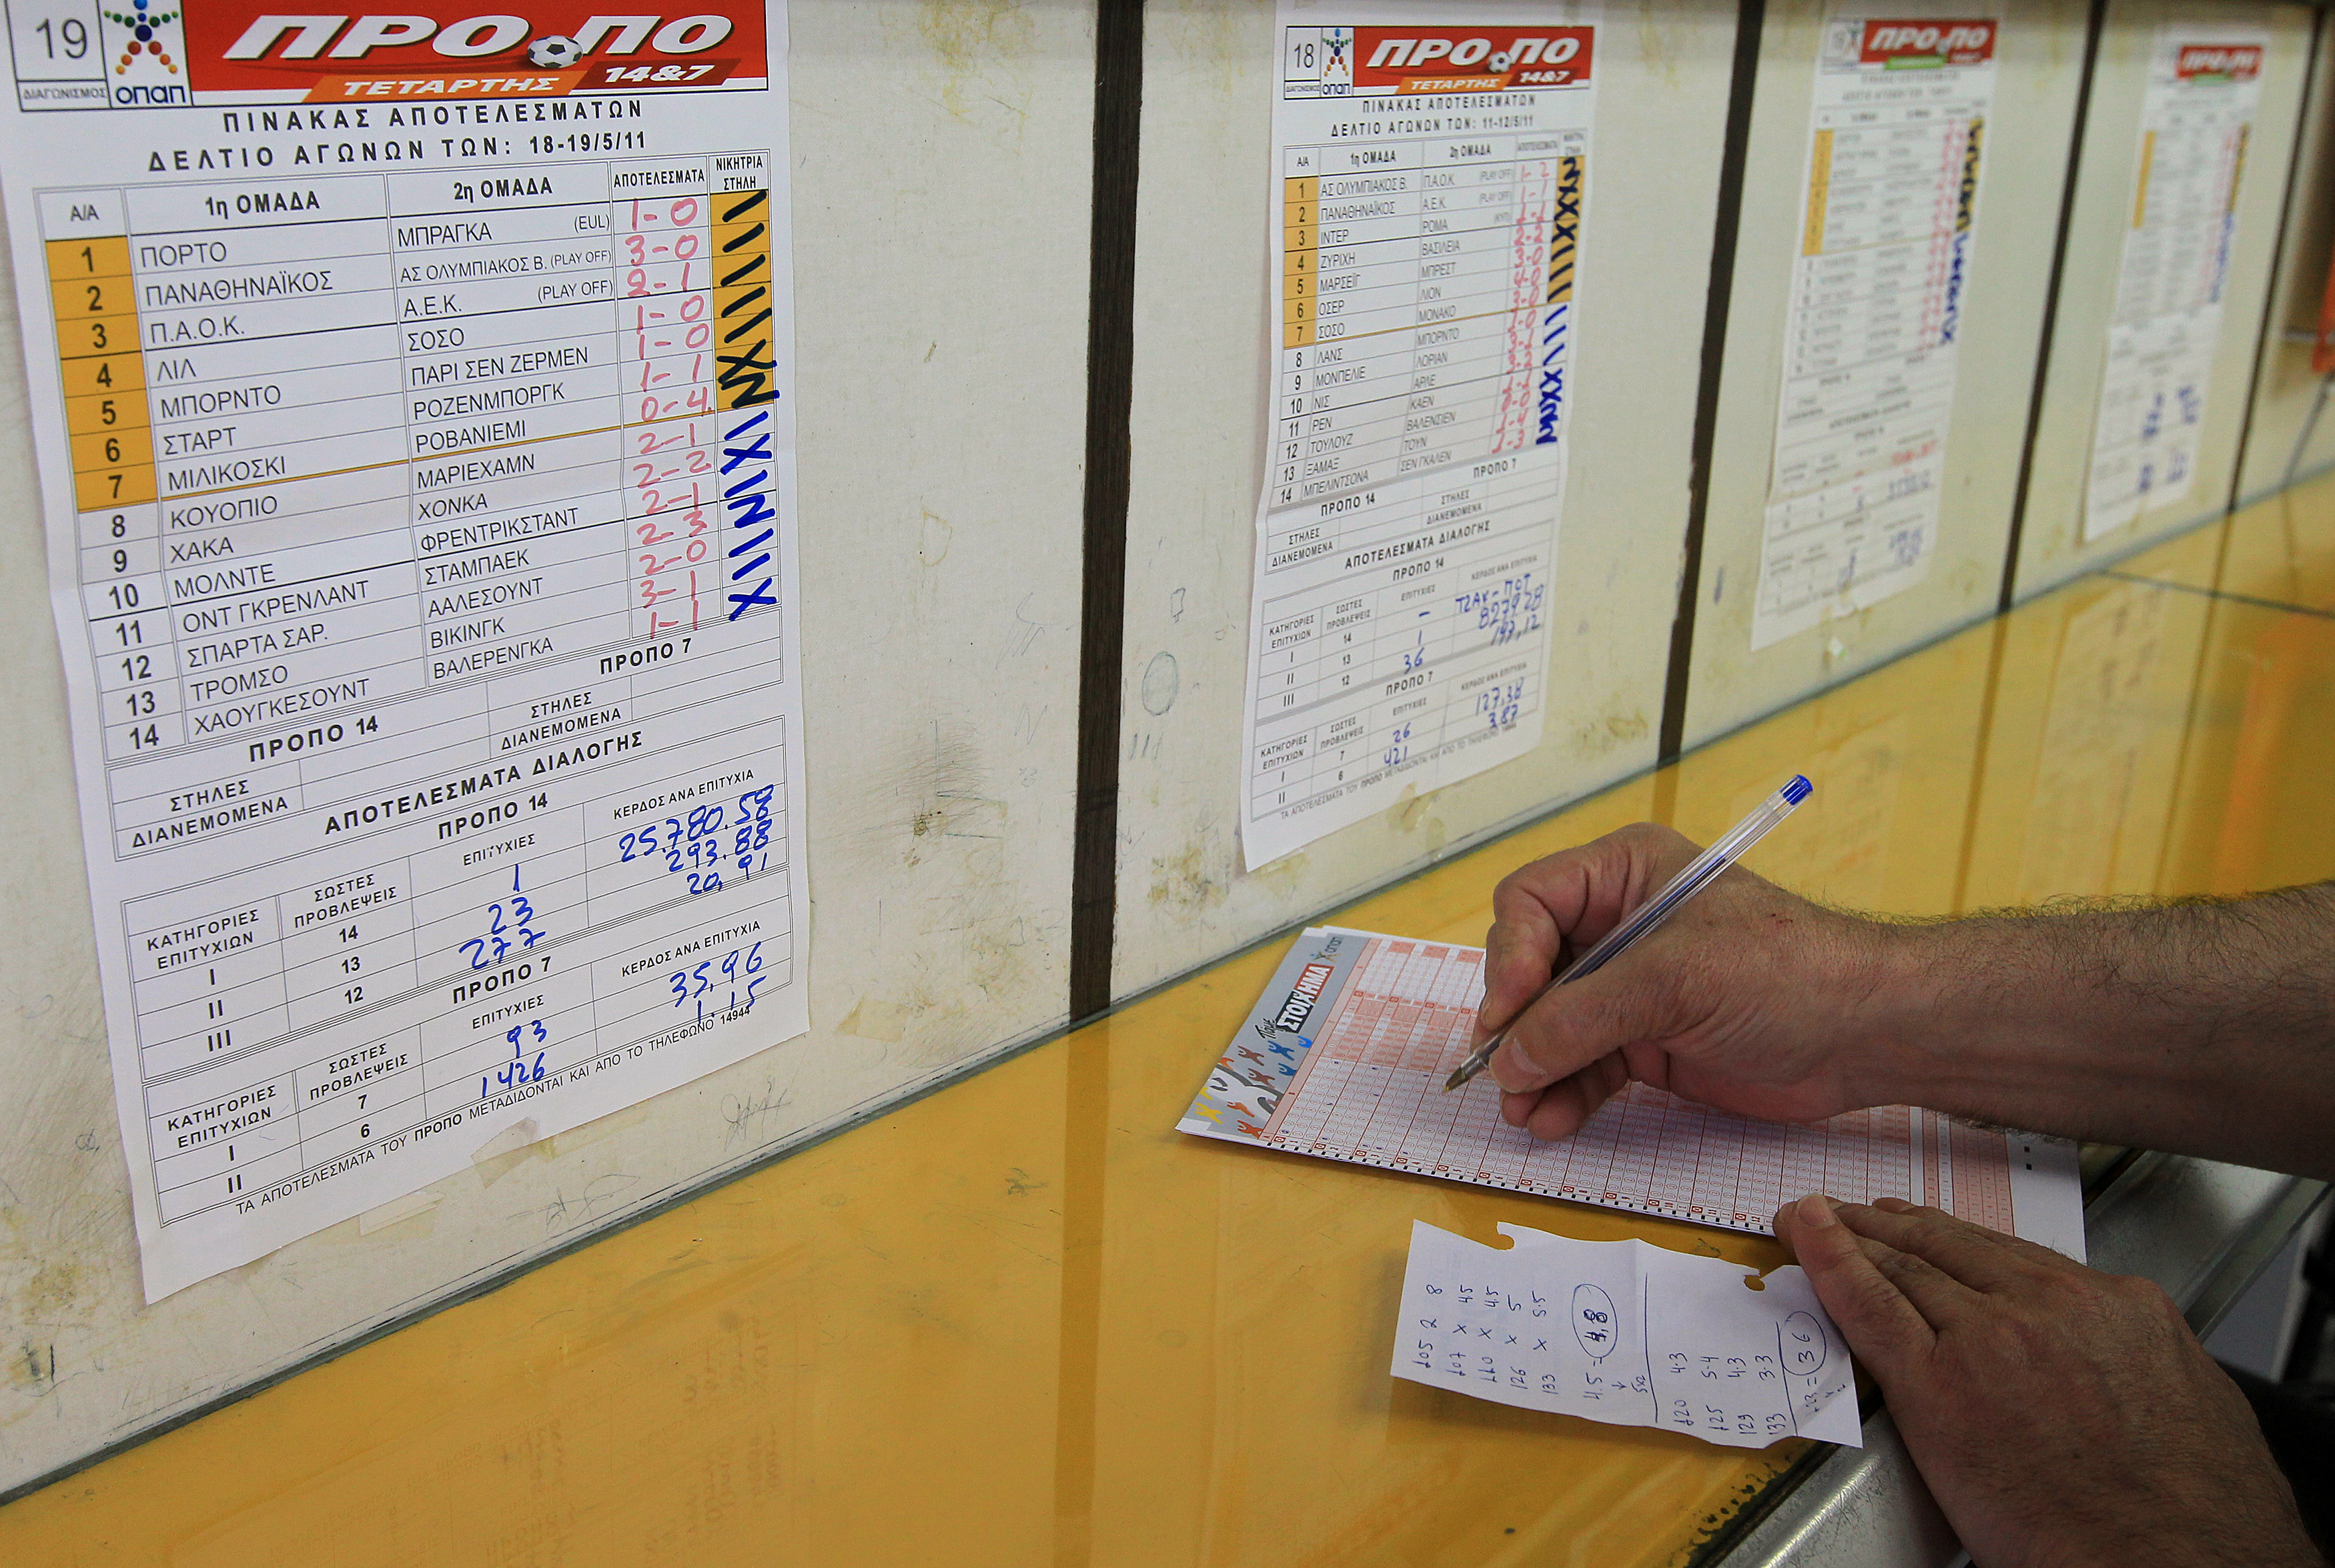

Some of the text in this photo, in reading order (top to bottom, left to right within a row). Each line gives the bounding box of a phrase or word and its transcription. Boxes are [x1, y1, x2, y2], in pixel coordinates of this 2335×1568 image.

[36, 19, 87, 59] 19
[1294, 43, 1314, 68] 18
[343, 77, 565, 95] ΤΕΤΑΡΤΗΣ
[604, 65, 715, 83] 14&7
[1411, 78, 1501, 90] ΤΕΤΑΡΤΗΣ
[1519, 70, 1570, 83] 14&7
[23, 86, 107, 101] ΔΙΑΓΩΝΙΣΜΟΣ
[1362, 95, 1535, 113] ΠΙΝΑΚΑΣ ΑΠΟΤΕΛΕΣΜΑΤΩΝ
[223, 99, 642, 133] ΠΙΝΑΚΑΣ ΑΠΟΤΕΛΕΣΜΑΤΩΝ
[1330, 121, 1381, 137] ΔΕΛΤΙΟ
[1388, 119, 1440, 133] ΑΓΩΝΩΝ
[148, 131, 646, 172] ΔΕΛΤΙΟ ΑΓΩΝΩΝ ΤΩΝ: 18-19/5/11
[715, 155, 763, 171] ΝΙΚΗΤΡΙΑ
[1363, 151, 1396, 163] ΟΜΑΔΑ
[453, 176, 552, 203] 2η ΟΜΑΔΑ
[613, 169, 705, 188] ΑΠΟΤΕΛΕΣΜΑΤΑ
[723, 175, 757, 191] ΣΤΗΛΗ
[1320, 177, 1398, 197] ΑΣ ΟΛΥΜΠΙΑΚΟΣ
[205, 191, 320, 218] 1η ΟΜΑΔΑ
[1298, 205, 1306, 223] 2
[398, 213, 610, 248] ΜΠΡΑΓΚΑ (EUL)
[1298, 229, 1305, 246] 3
[1320, 229, 1350, 243] ΙΝΤΕΡ
[81, 247, 93, 272] 1
[140, 242, 227, 268] ΠΟΡΤΟ
[401, 265, 422, 282] ΑΣ
[426, 258, 529, 281] ΟΛΥΜΠΙΑΚΟΣ
[550, 253, 583, 267] (PLAY
[586, 249, 612, 264] OFF)
[1321, 251, 1356, 269] ΖΥΡΙΧΗ
[87, 285, 103, 311] 2
[146, 271, 333, 307] ΠΑΝΑΘΗΝΑΪΚΟΣ
[537, 284, 578, 303] (PLAY
[580, 281, 613, 297] OFF)
[1318, 299, 1345, 316] ΟΣΕΡ
[92, 324, 107, 348] 3
[151, 315, 245, 344] Π.Α.Ο.Κ.
[408, 327, 464, 352] ΣΟΣΟ
[1318, 323, 1346, 339] ΣΟΣΟ
[412, 347, 588, 386] ΠΑΡΙ ΣΕΝ ΖΕΡΜΕΝ
[1318, 347, 1343, 363] ΛΑΝΣ
[97, 363, 112, 387] 4
[157, 358, 197, 381] ΛΙΛ
[102, 401, 116, 426] 5
[161, 385, 282, 419] ΜΠΟΡΝΤΟ
[414, 382, 565, 420] ΡΟΖΕΝΜΠΟΡΓΚ
[1290, 398, 1303, 414] 10
[1314, 395, 1330, 410] ΝΙΣ
[416, 420, 525, 453] ΡΟΒΑΝΙΕΜΙ
[1289, 422, 1300, 438] 11
[1312, 417, 1332, 432] ΡΕΝ
[105, 438, 121, 463] 6
[164, 427, 236, 456] ΣΤΑΡΤ
[1286, 443, 1298, 459] 12
[1310, 433, 1353, 454] ΤΟΥΛΟΥΖ
[169, 456, 286, 491] ΜΙΛΙΚΟΣΚΙ
[418, 454, 536, 490] ΜΑΡΙΕΧΑΜΝ
[109, 475, 122, 499] 7
[1281, 488, 1292, 504] 14
[170, 496, 278, 530] ΚΟΥΟΠΙΟ
[418, 493, 488, 521] ΧΟΝΚΑ
[1322, 493, 1376, 516] ΠΡΟΠΟ 14
[111, 515, 126, 538] 8
[421, 508, 578, 554] ΦΡΕΝΤΡΙΚΣΤΑΝΤ
[1289, 527, 1320, 546] ΣΤΗΛΕΣ
[170, 537, 234, 564] ΧΑΚΑ
[1272, 541, 1334, 568] ΔΙΑΝΕΜΟΜΕΝΑ
[1344, 520, 1491, 570] ΑΠΟΤΕΛΕΣΜΑΤΑ ΔΙΑΛΟΓΗΣ
[113, 550, 128, 574] 9
[425, 548, 529, 586] ΣΤΑΜΠΑΕΚ
[1393, 561, 1431, 581] ΠΡΟΠΟ
[174, 564, 277, 599] ΜΟΛΝΤΕ
[109, 584, 139, 610] 10
[182, 580, 369, 634] ΟΝΤ ΓΚΡΕΝΛΑΝΤ
[428, 577, 543, 618] ΑΑΛΕΣΟΥΝΤ
[115, 620, 143, 646] 11
[430, 616, 505, 649] ΒΙΚΙΝΓΚ
[1269, 614, 1315, 636] ΚΑΤΗΓΟΡΙΕΣ
[189, 623, 329, 668] ΣΠΑΡΤΑ ΣΑΡ.
[434, 636, 554, 679] ΒΑΛΕΡΕΝΓΚΑ
[600, 638, 692, 676] ΠΡΟΠΟ 7
[121, 655, 152, 682] 12
[190, 666, 289, 702] ΤΡΟΜΣΟ
[125, 690, 156, 717] 13
[195, 678, 370, 736] ΧΑΟΥΓΚΕΣΟΥΝΤ
[129, 724, 159, 750] 14
[249, 716, 379, 763] ΠΡΟΠΟ 14
[501, 708, 622, 750] ΔΙΑΝΕΜΟΜΕΝΑ
[324, 730, 643, 834] ΑΠΟΤΕΛΕΣΜΑΤΑ ΔΙΑΛΟΓΗΣ
[613, 769, 754, 820] ΚΕΡΔΟΣ ΑΝΑ ΕΠΙΤΥΧΙΑ
[170, 779, 250, 812] ΣΤΗΛΕΣ
[131, 796, 289, 848] ΔΙΑΝΕΜΟΜΕΝΑ
[463, 832, 536, 867] ΕΠΙΤΥΧΙΕΣ
[314, 873, 376, 902] ΣΩΣΤΕΣ
[294, 886, 398, 929] ΠΡΟΒΛΕΨΕΙΣ
[488, 896, 534, 934] 23
[147, 909, 259, 952] ΚΑΤΗΓΟΡΙΕΣ
[157, 930, 255, 970] ΕΠΙΤΥΧΙΩΝ
[236, 1006, 751, 1215] ΤΑ ΑΠΟΤΕΛΕΣΜΑΤΑ ΤΟΥ ΠΡΟΠΟ ΜΕΤΑΔΙΔΟΝΤΑΙ ΚΑΙ ΑΠΟ ΤΟ ΤΗΛΕΦΩΝΟ 14944
